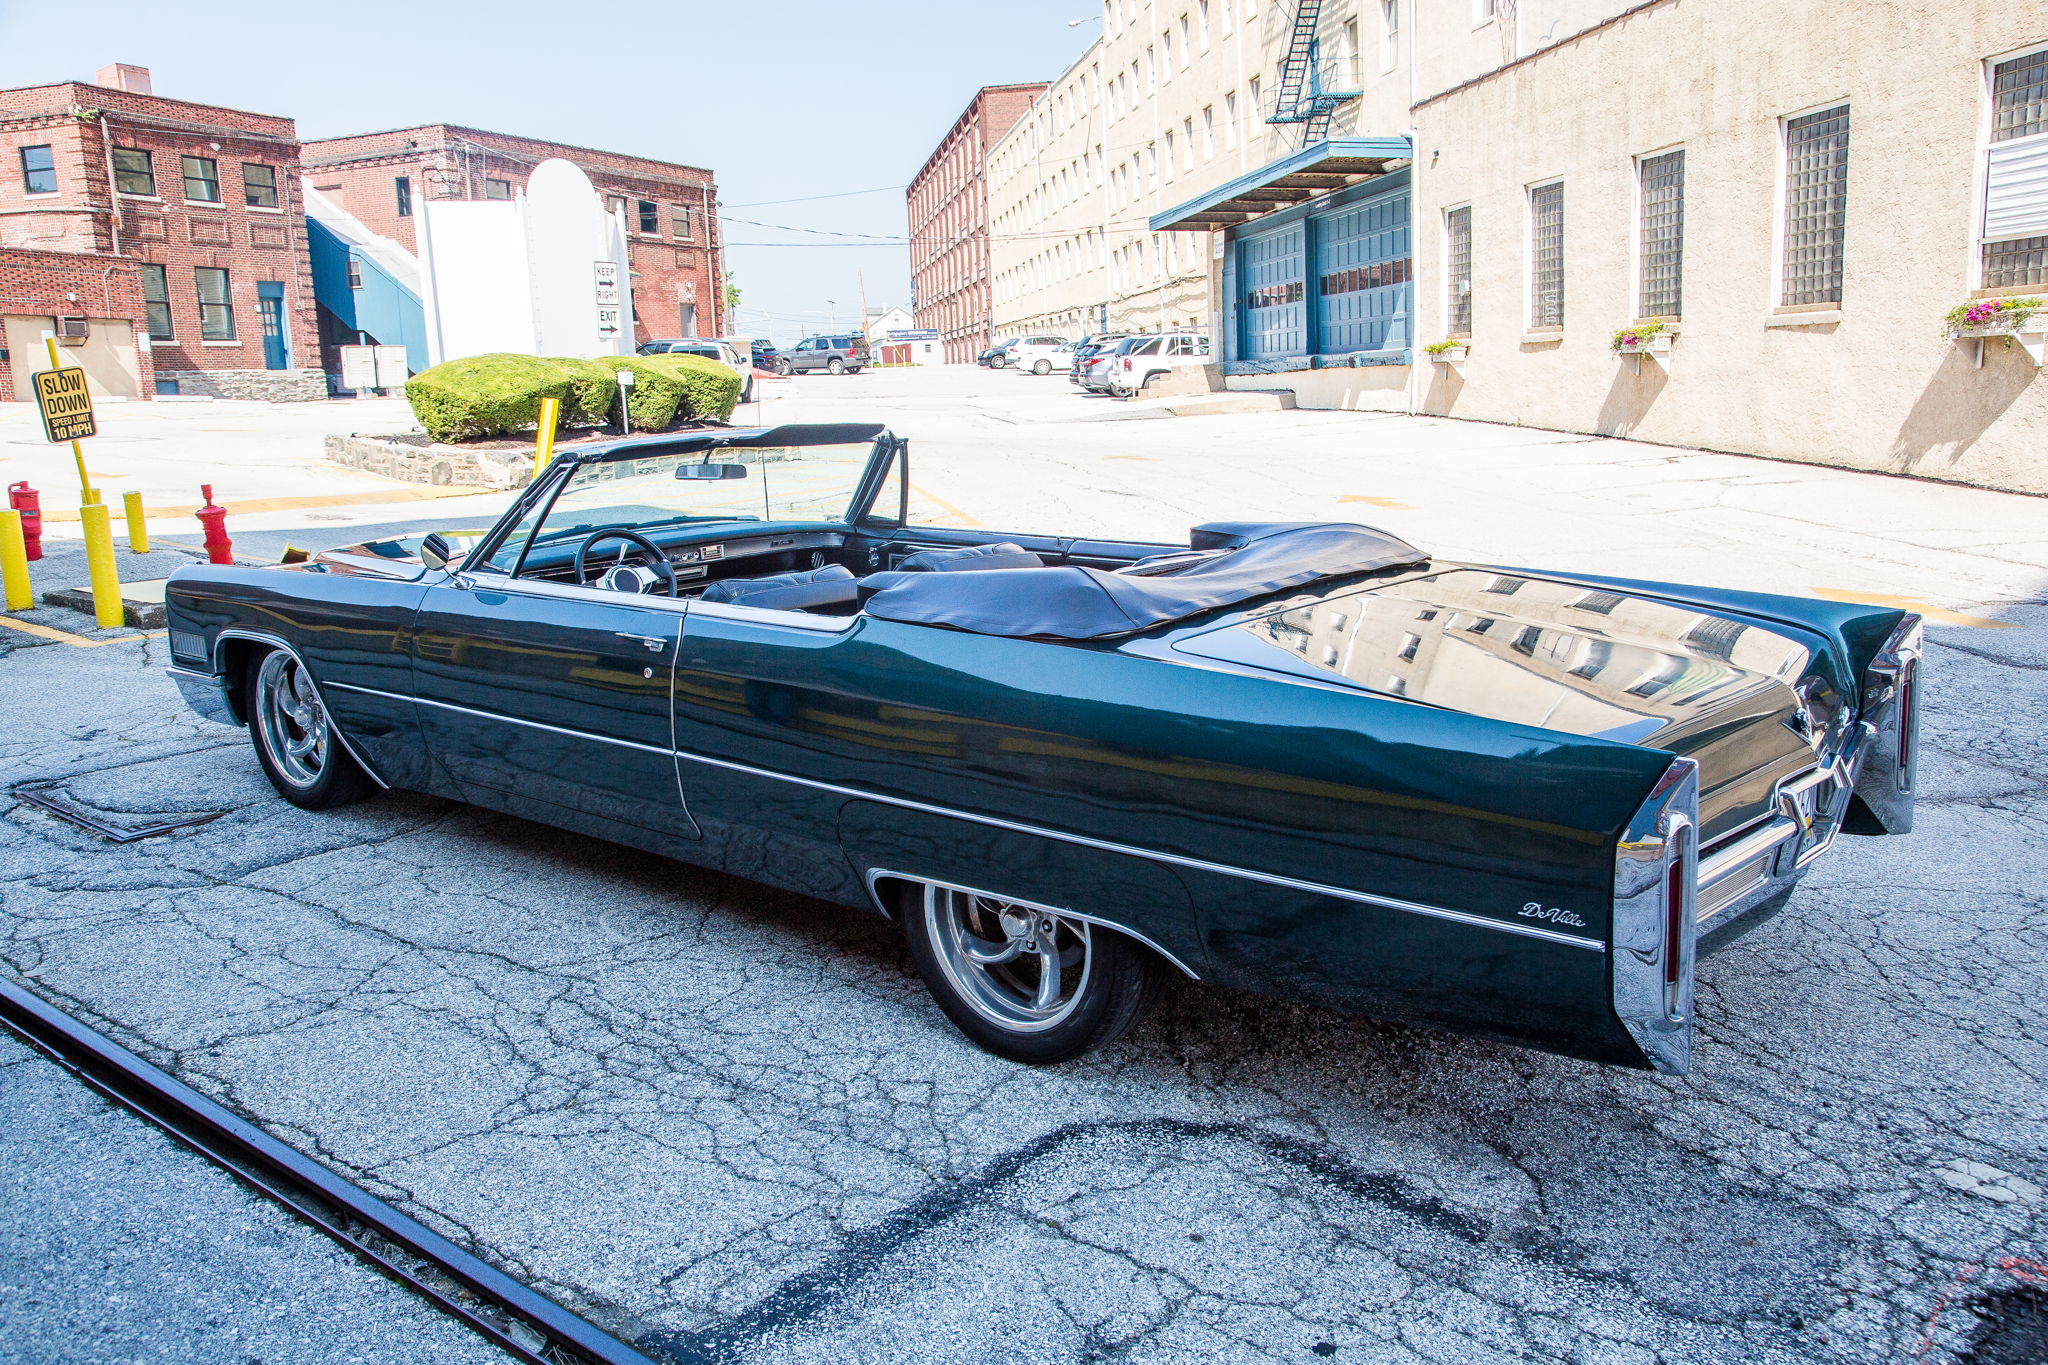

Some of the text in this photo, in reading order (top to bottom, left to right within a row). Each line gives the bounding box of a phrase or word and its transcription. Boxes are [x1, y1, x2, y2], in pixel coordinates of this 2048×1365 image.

[597, 267, 615, 277] KEEP
[597, 290, 617, 300] RIGHT
[600, 311, 617, 321] EXIT
[43, 374, 80, 395] SLOW
[47, 393, 88, 415] DOWN
[52, 413, 90, 427] SPEED LIMIT
[54, 422, 93, 440] 10 MPH
